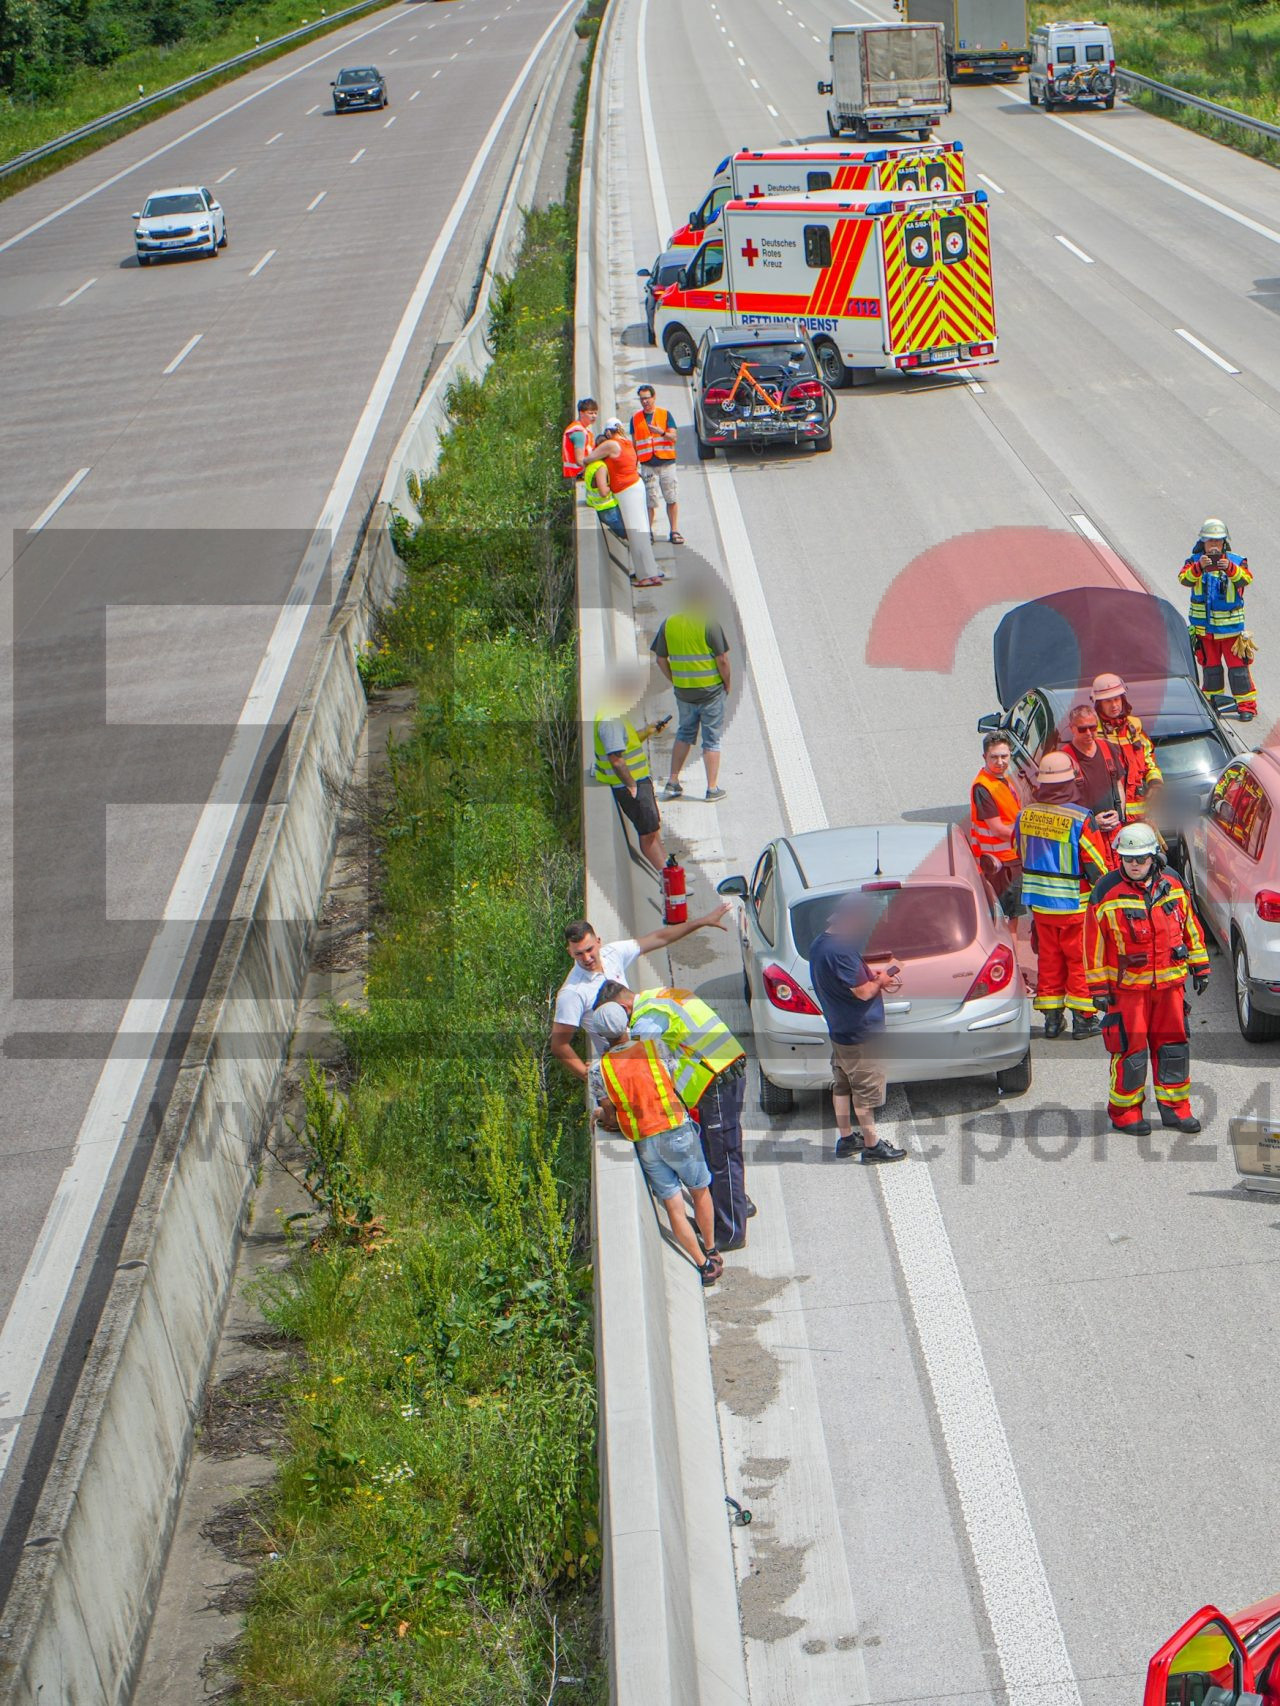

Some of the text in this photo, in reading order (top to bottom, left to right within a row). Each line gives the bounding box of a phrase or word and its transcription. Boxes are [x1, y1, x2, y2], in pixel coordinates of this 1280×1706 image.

[767, 184, 801, 192] Deutsches
[761, 238, 797, 248] Deutsches
[762, 249, 782, 257] Rotes
[763, 259, 782, 268] Kreuz
[855, 300, 879, 315] 112
